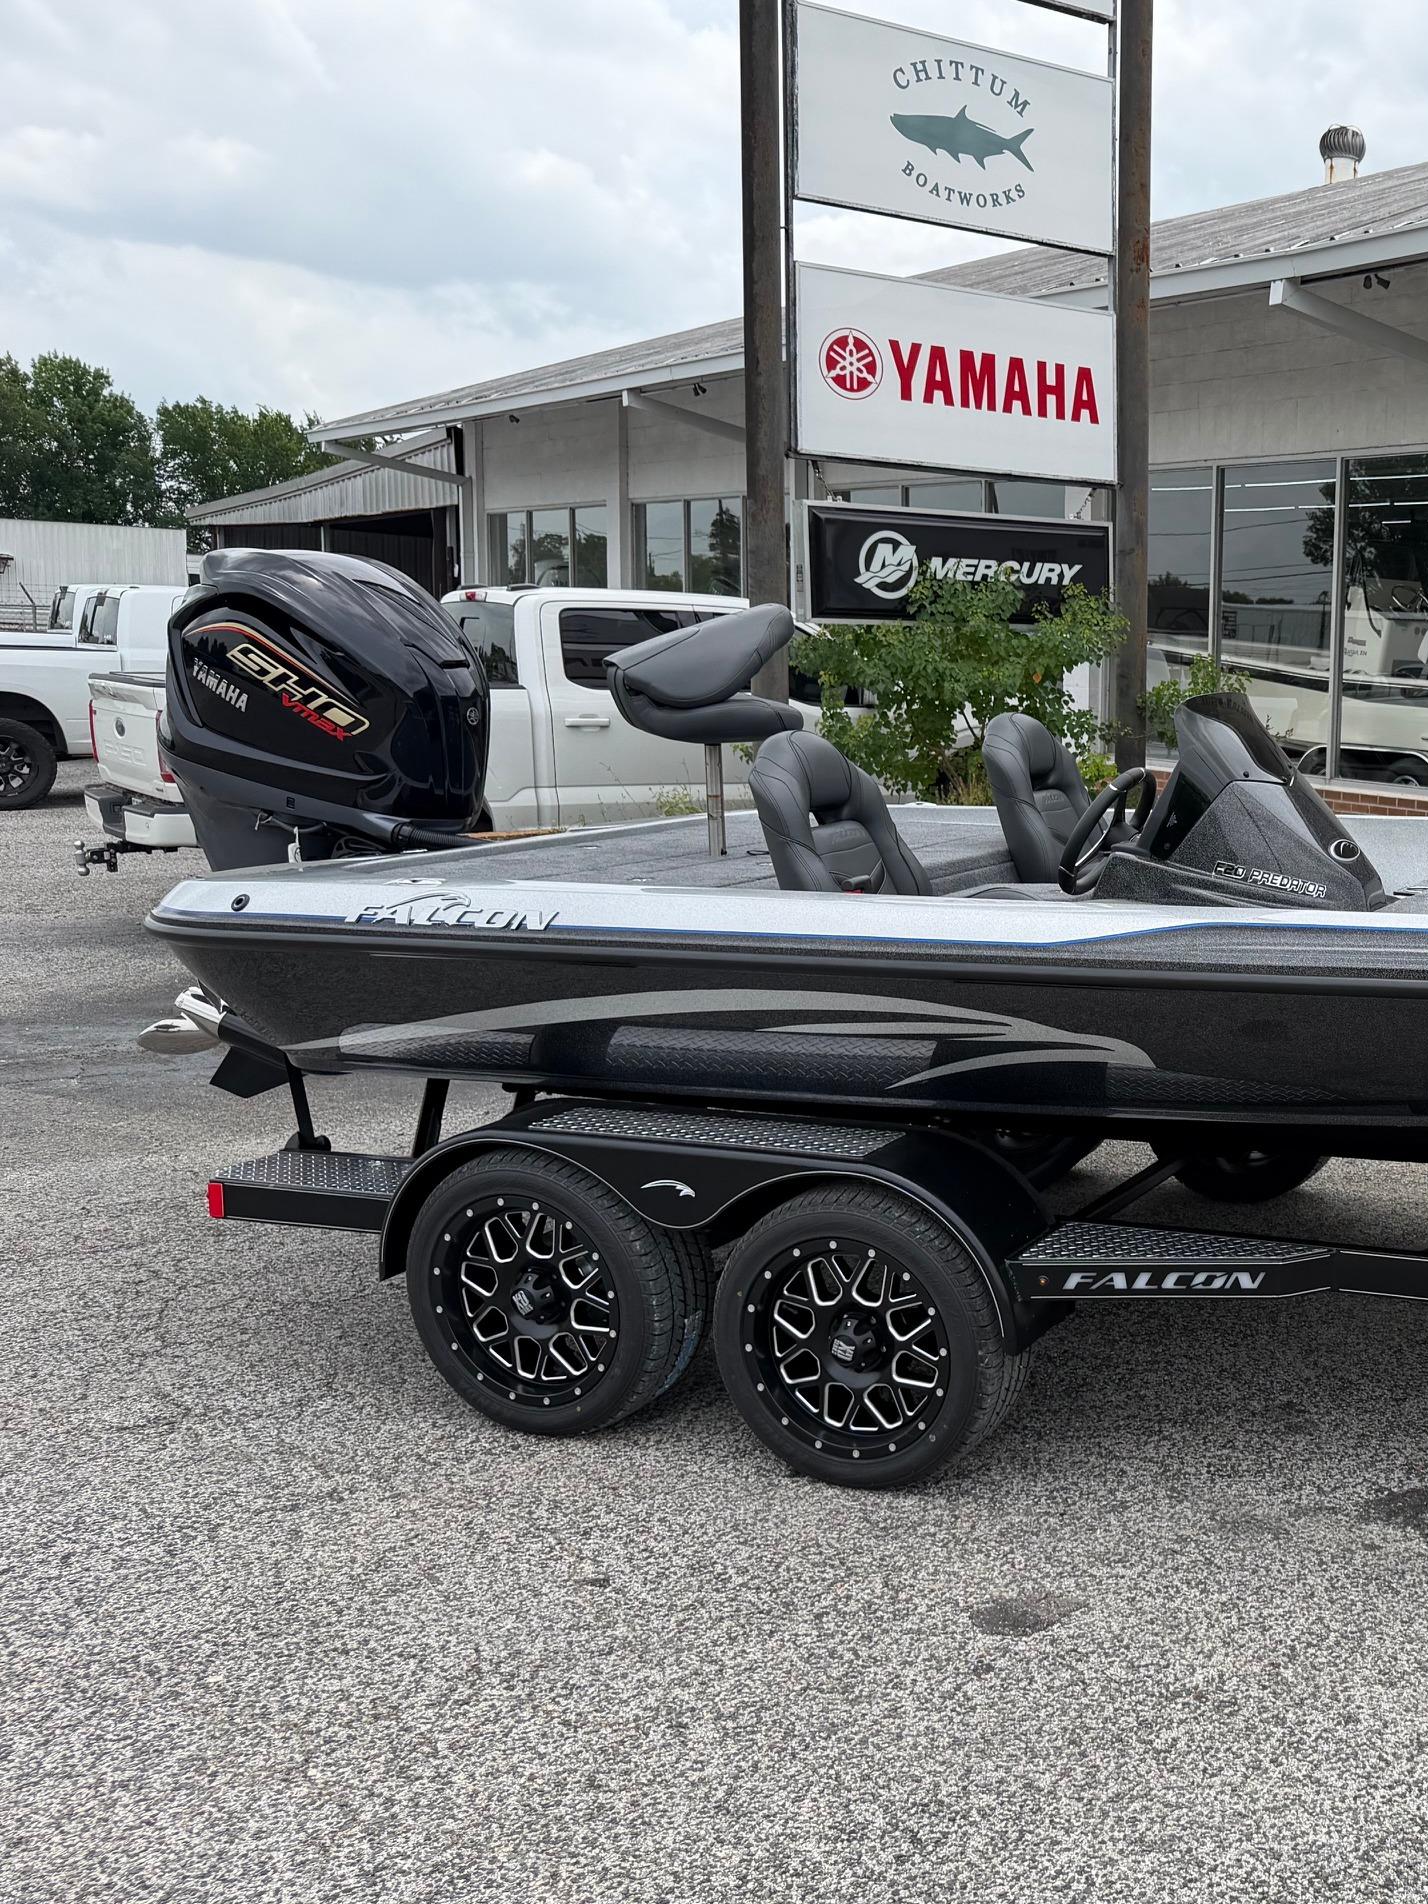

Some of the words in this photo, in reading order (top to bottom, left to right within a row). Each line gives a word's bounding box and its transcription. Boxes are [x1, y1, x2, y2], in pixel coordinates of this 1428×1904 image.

[893, 59, 1031, 118] CHITTUM
[901, 160, 1026, 208] BOATWORKS
[888, 338, 1100, 425] YAMAHA
[927, 557, 1083, 585] MERCURY
[192, 658, 248, 712] YAMAHA
[1248, 868, 1327, 898] PREDATOR
[344, 905, 560, 931] FALCON
[1062, 1271, 1266, 1290] FALCON
